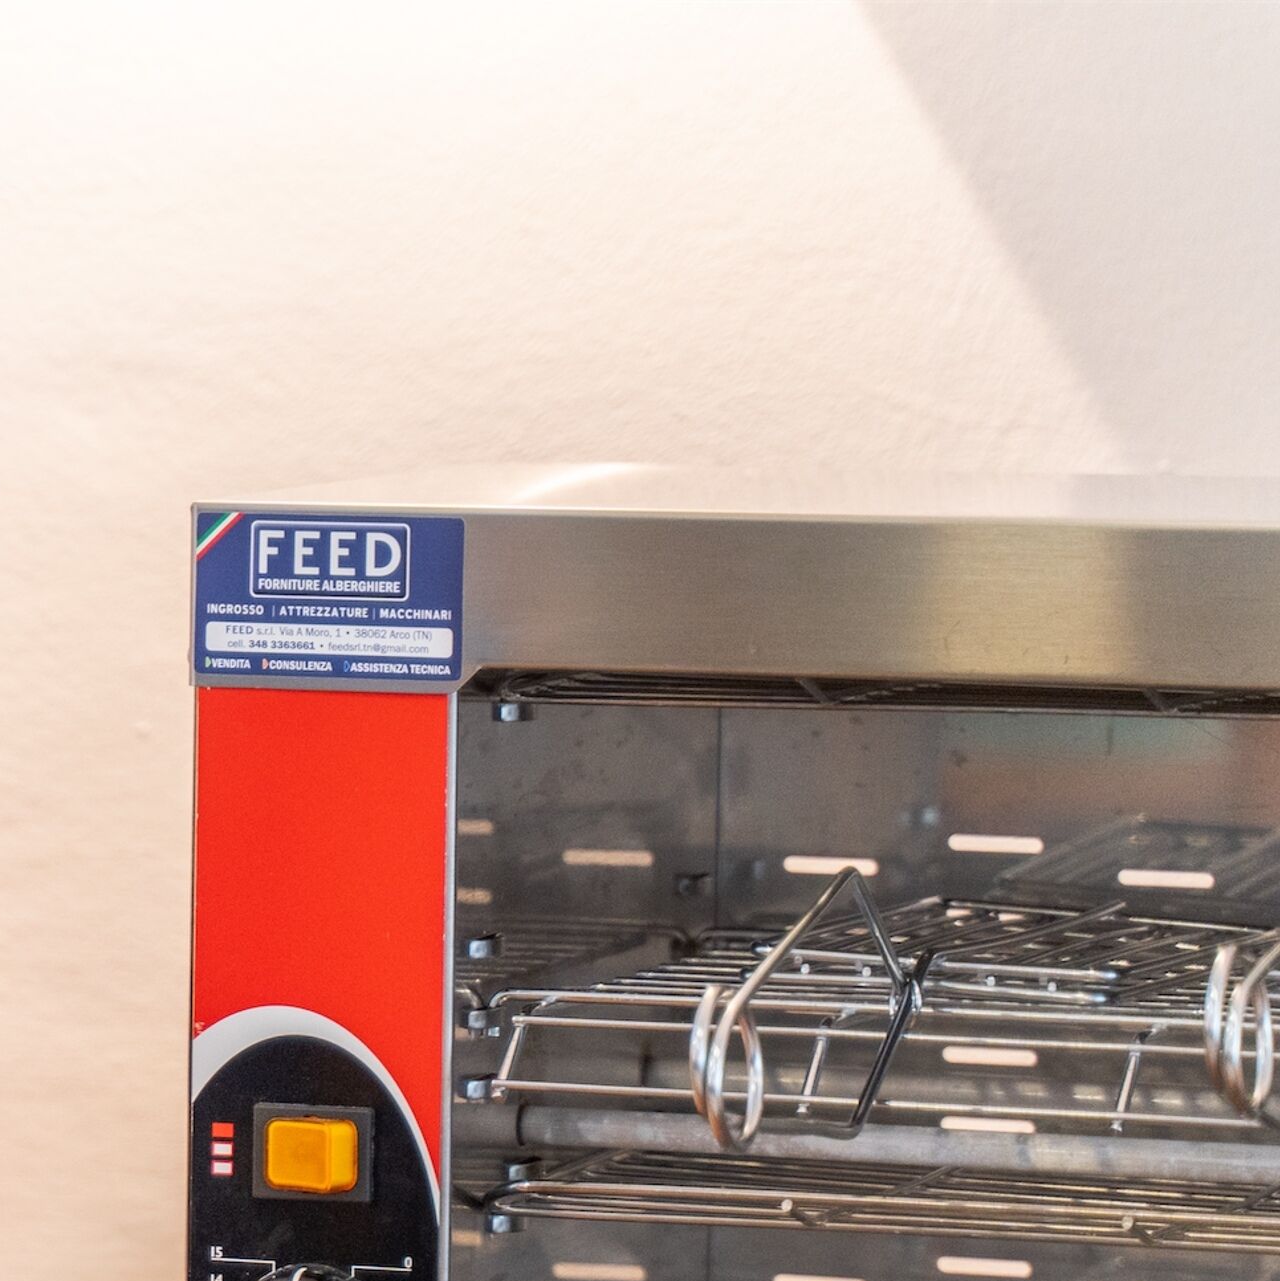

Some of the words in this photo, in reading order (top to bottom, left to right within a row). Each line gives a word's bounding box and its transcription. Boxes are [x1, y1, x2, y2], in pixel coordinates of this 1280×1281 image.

[258, 529, 402, 577] FEED
[258, 578, 320, 591] FORNITURE
[321, 579, 401, 593] ALBERGHIERE
[206, 603, 265, 616] INGROSSO
[279, 605, 369, 619] ATTREZZATURE
[379, 608, 452, 621] MACCHINARI
[225, 625, 254, 635] FEED
[248, 639, 269, 650] 348
[211, 658, 251, 669] VENDITA
[269, 659, 333, 672] CONSULENZA
[350, 661, 409, 674] ASSISTENZA
[409, 664, 452, 675] TECNICA
[211, 1246, 223, 1259] 15
[404, 1256, 413, 1269] 0
